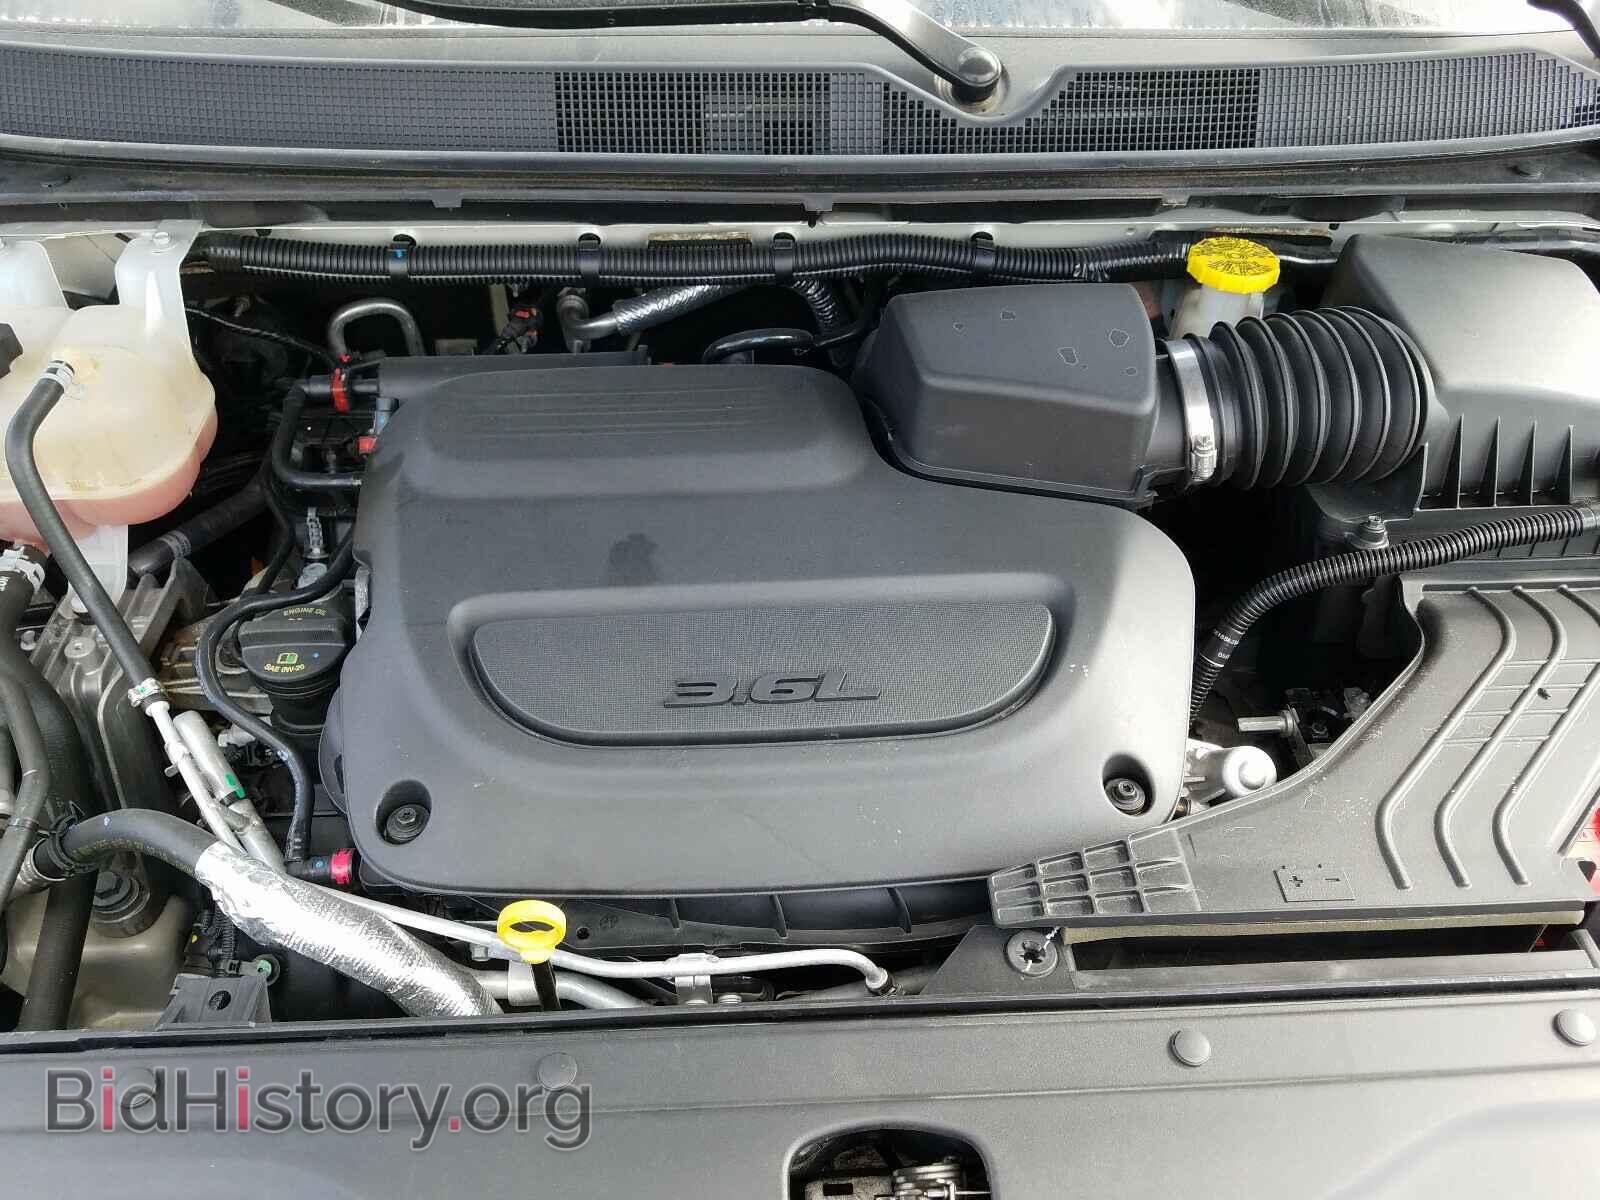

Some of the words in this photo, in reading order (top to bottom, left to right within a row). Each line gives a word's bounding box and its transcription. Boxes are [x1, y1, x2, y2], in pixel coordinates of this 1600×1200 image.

[283, 607, 314, 616] ENGINE
[264, 663, 281, 672] SAE
[664, 672, 880, 708] 3.6L
